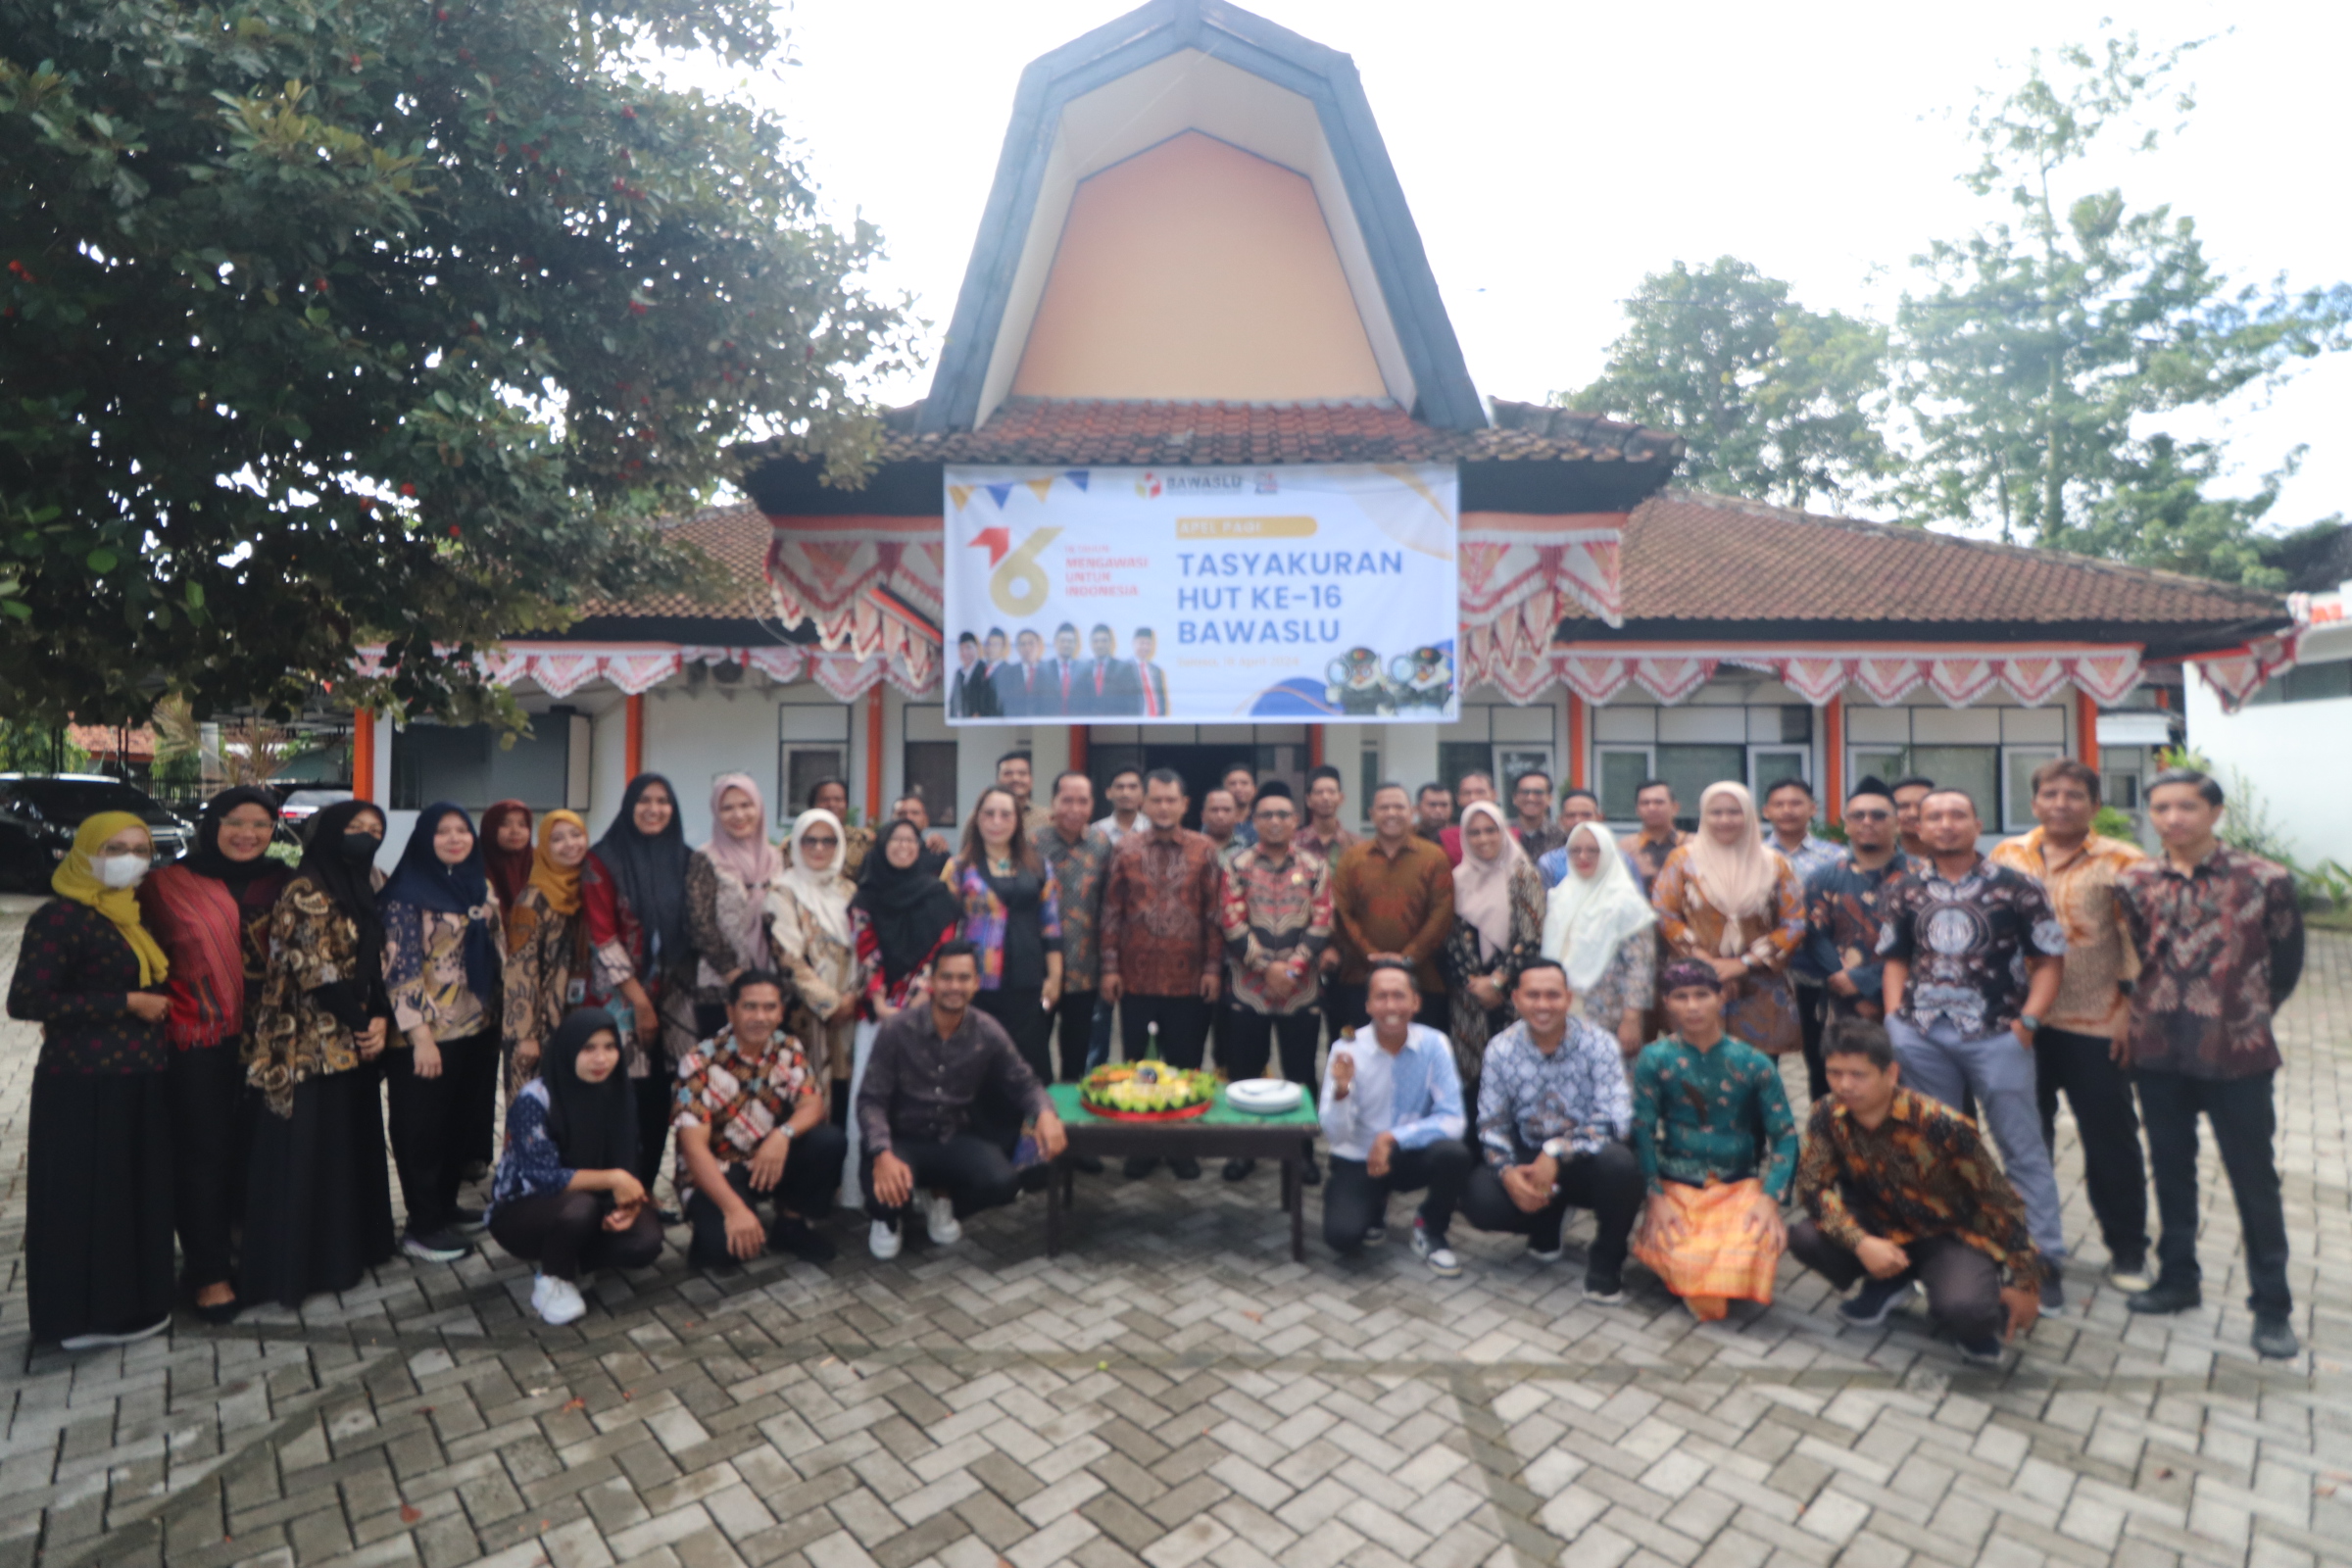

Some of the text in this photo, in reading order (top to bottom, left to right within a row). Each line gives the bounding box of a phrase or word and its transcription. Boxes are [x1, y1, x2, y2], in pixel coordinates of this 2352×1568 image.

[1166, 475, 1242, 490] BAWASLU
[1179, 520, 1262, 534] APEL PAGI
[1065, 558, 1149, 567] MENGAWASI
[1177, 551, 1402, 576] TASYAKURAN
[1065, 571, 1111, 583] UNTUK
[1065, 585, 1139, 597] INDONESIA
[1177, 585, 1342, 610] HUT KE-16
[1177, 619, 1340, 644] BAWASLU
[1240, 656, 1266, 667] April
